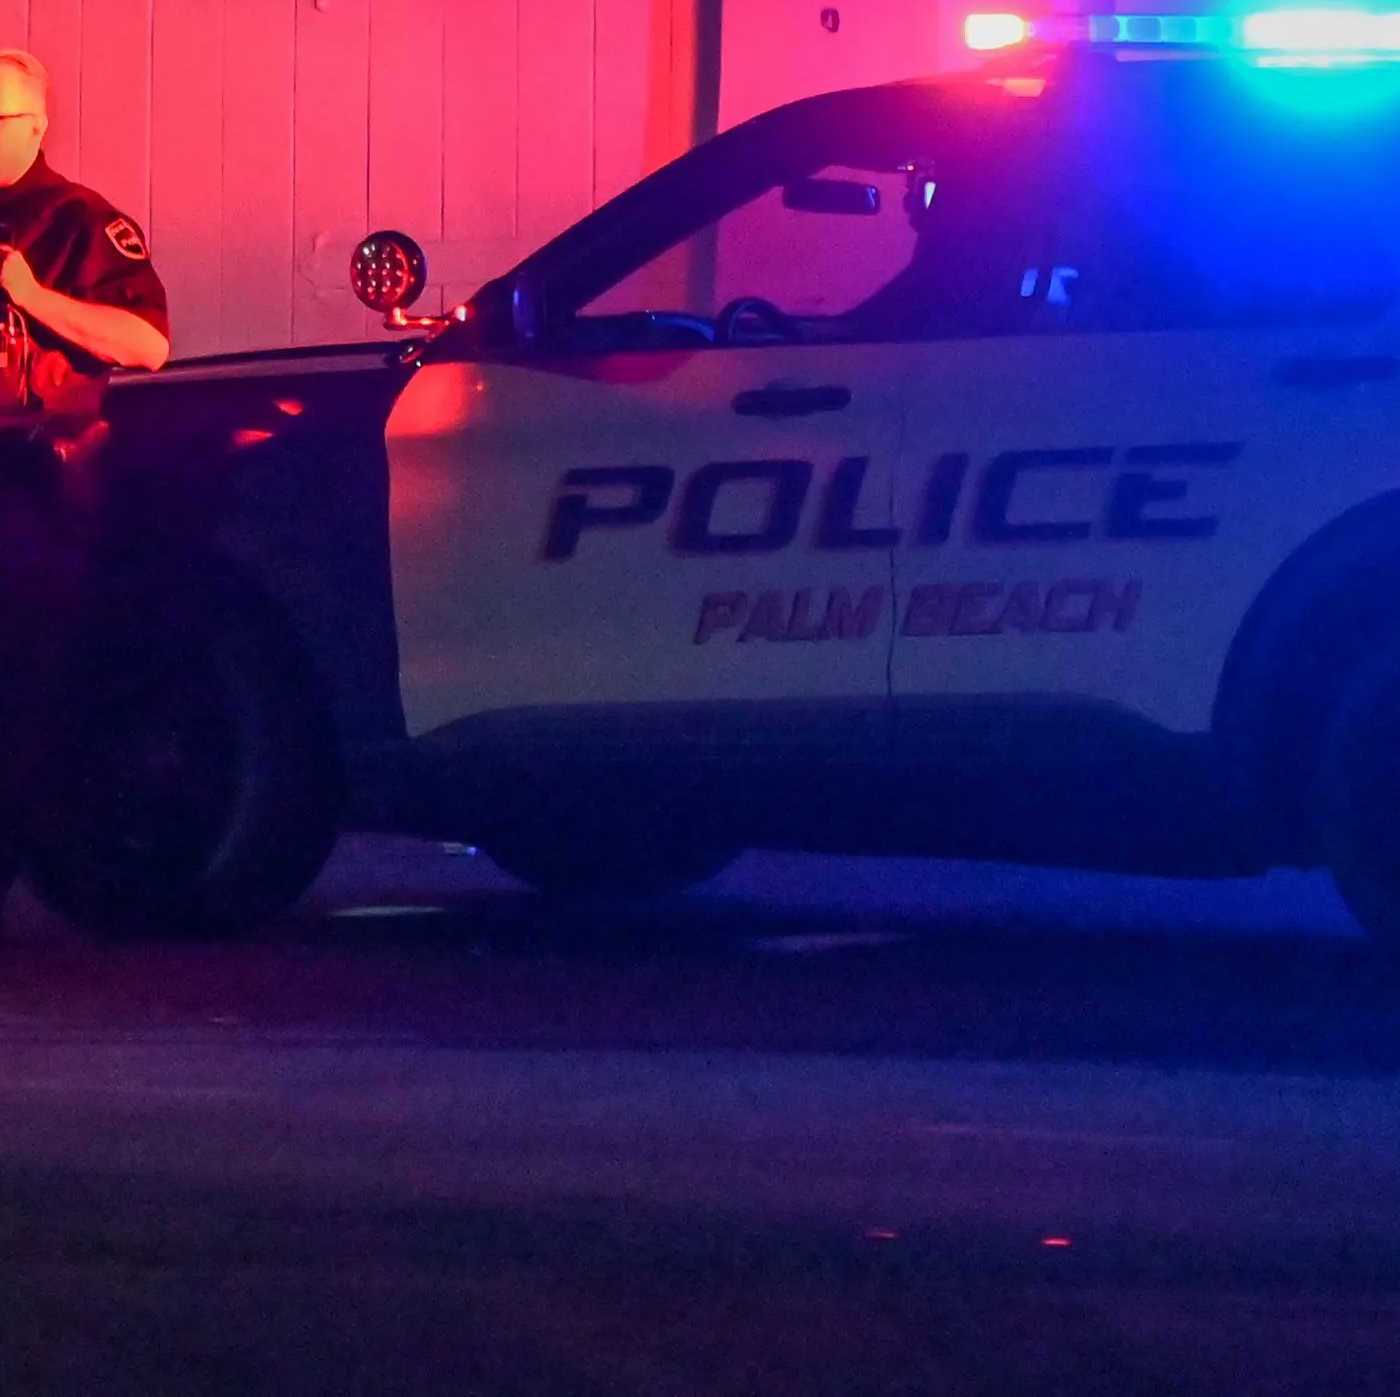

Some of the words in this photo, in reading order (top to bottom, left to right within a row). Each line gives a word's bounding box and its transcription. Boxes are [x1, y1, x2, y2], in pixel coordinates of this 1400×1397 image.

[540, 441, 1245, 562] POLICE
[693, 587, 883, 644] PALM
[902, 578, 1143, 636] BEACH
